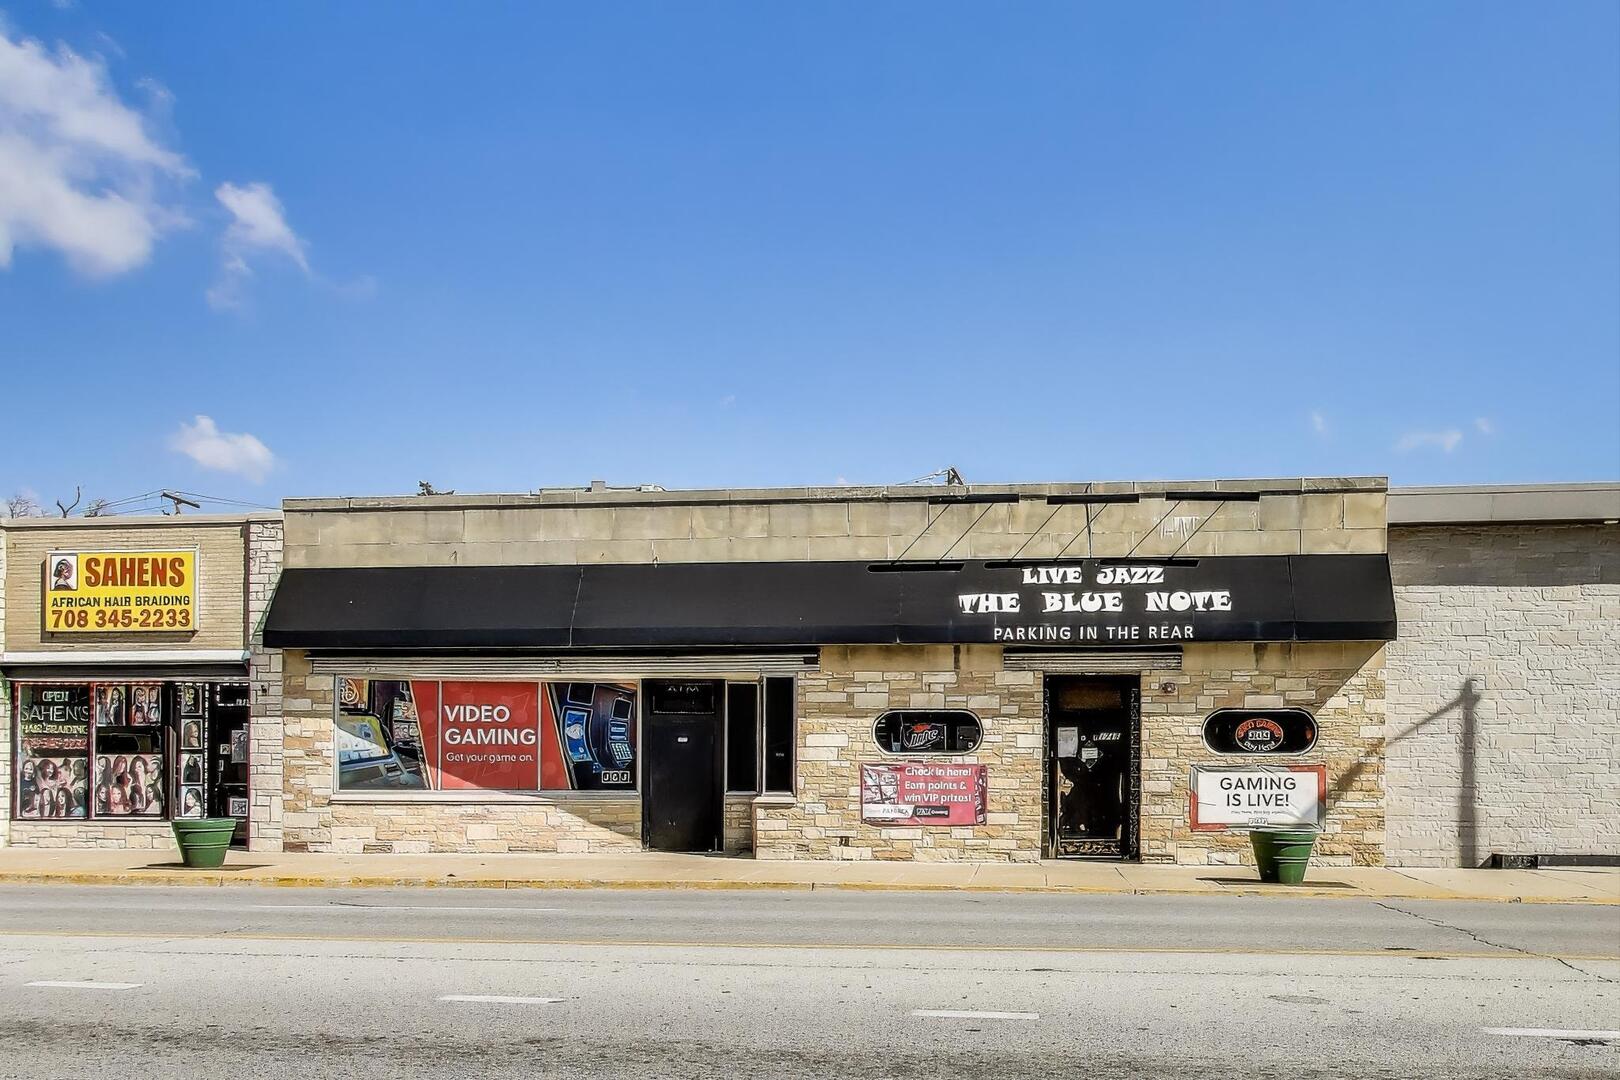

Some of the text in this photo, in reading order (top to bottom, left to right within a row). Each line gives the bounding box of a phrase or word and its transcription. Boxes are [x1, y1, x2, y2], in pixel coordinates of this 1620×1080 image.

[85, 557, 185, 587] SAHENS
[1022, 566, 1165, 584] LIVE JAZZ
[51, 595, 190, 607] AFRICAN HAIR BRAIDING
[958, 591, 1233, 613] THE BLUE NOTE
[51, 608, 190, 628] 708 345-2233
[993, 625, 1195, 641] PARKING IN THE REAR
[42, 690, 69, 702] OPEN
[21, 704, 89, 722] SAHEN'S
[444, 704, 510, 723] VIDEO
[445, 728, 536, 746] GAMING
[446, 752, 534, 764] Get your game on.
[905, 767, 972, 776] Check in here!
[904, 781, 967, 791] Earn points &
[1220, 777, 1296, 791] GAMING
[904, 793, 972, 804] win VIP prizes!
[1226, 793, 1289, 807] IS LIVE!
